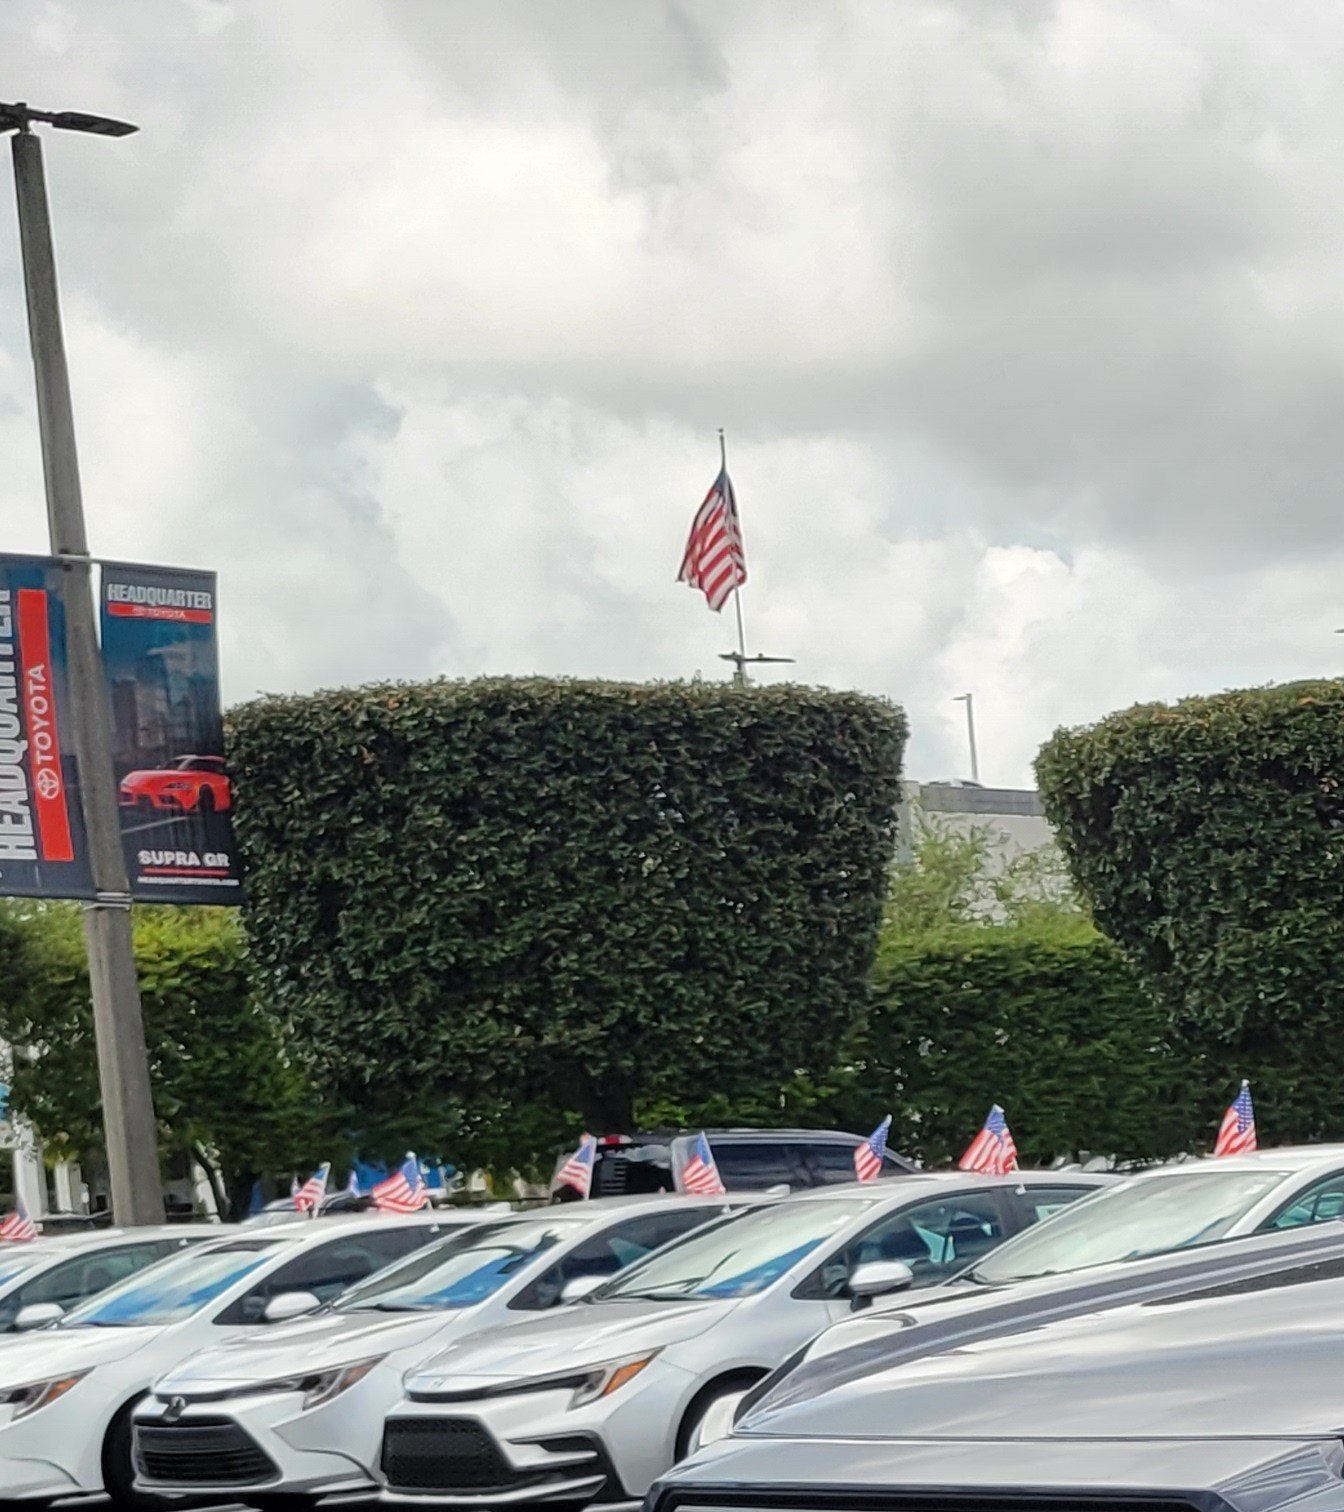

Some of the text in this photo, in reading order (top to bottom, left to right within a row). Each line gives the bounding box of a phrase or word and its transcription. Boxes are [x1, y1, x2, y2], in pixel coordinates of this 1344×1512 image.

[107, 583, 212, 609] HEADQUARTER
[27, 663, 54, 765] TOYOTA
[137, 849, 231, 868] SUPRA GR
